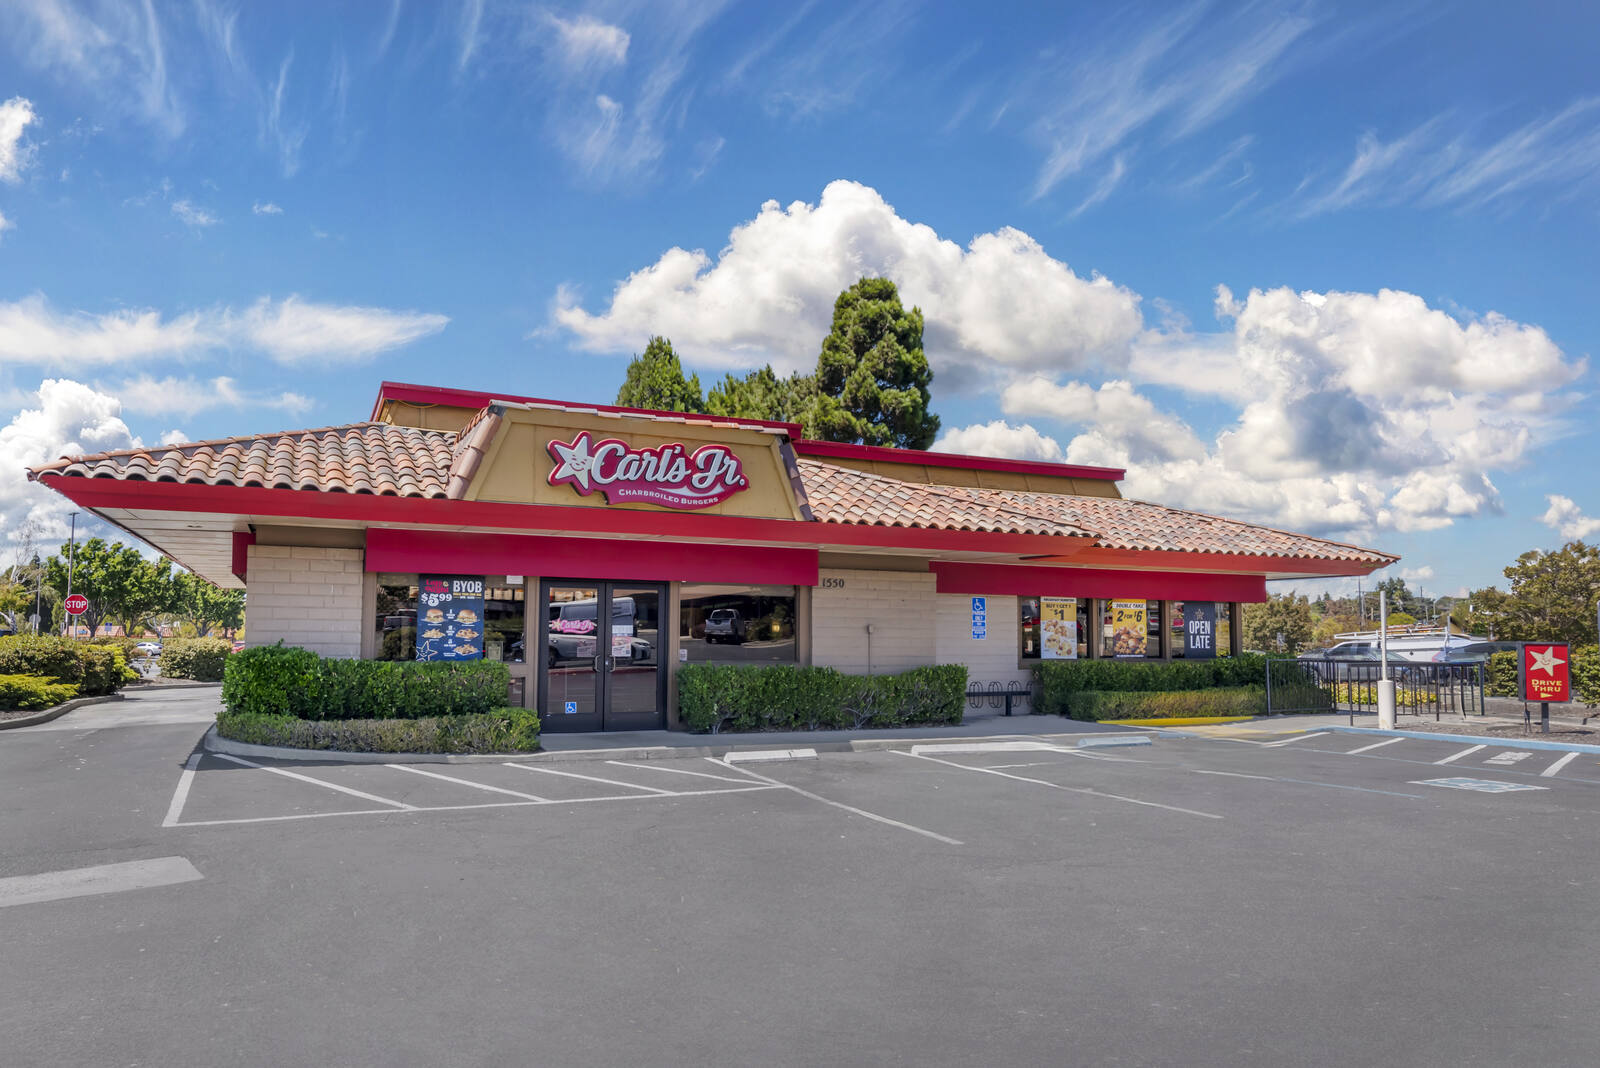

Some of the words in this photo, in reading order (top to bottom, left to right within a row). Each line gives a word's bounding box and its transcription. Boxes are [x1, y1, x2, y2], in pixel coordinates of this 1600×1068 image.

[591, 443, 691, 484] Carl's
[691, 448, 746, 489] Jr.
[453, 581, 482, 593] BYOB
[822, 578, 844, 588] 1550
[66, 600, 86, 609] STOP
[1117, 610, 1124, 622] 2
[1134, 611, 1143, 622] $6
[1189, 620, 1211, 635] OPEN
[1190, 635, 1211, 649] LATE
